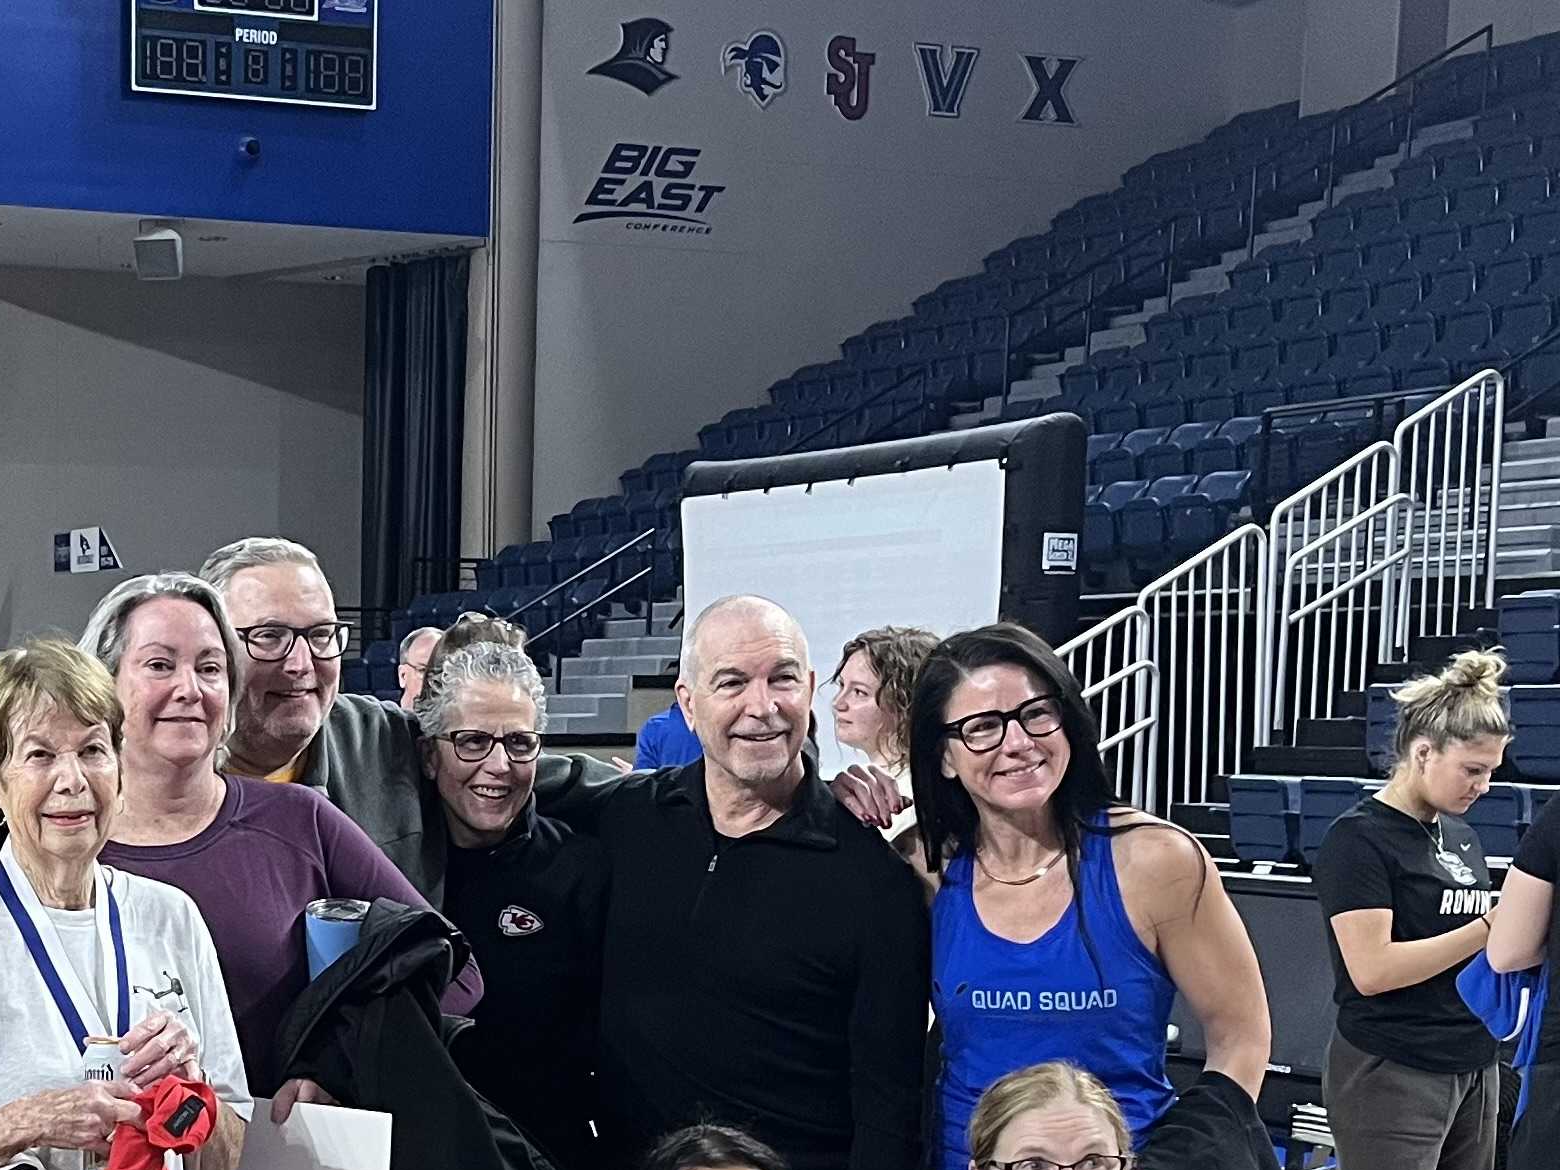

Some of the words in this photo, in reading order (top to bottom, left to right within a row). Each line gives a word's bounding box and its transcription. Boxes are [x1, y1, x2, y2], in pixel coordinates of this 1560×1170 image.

[235, 27, 278, 45] PERIOD
[913, 42, 980, 118] V
[1017, 51, 1083, 126] X
[601, 143, 701, 179] BIG
[584, 177, 726, 214] EAST
[625, 222, 713, 235] CONFERENCE
[1439, 888, 1491, 915] ROWIN
[971, 989, 1032, 1011] QUAD
[1039, 988, 1118, 1012] SQUAD
